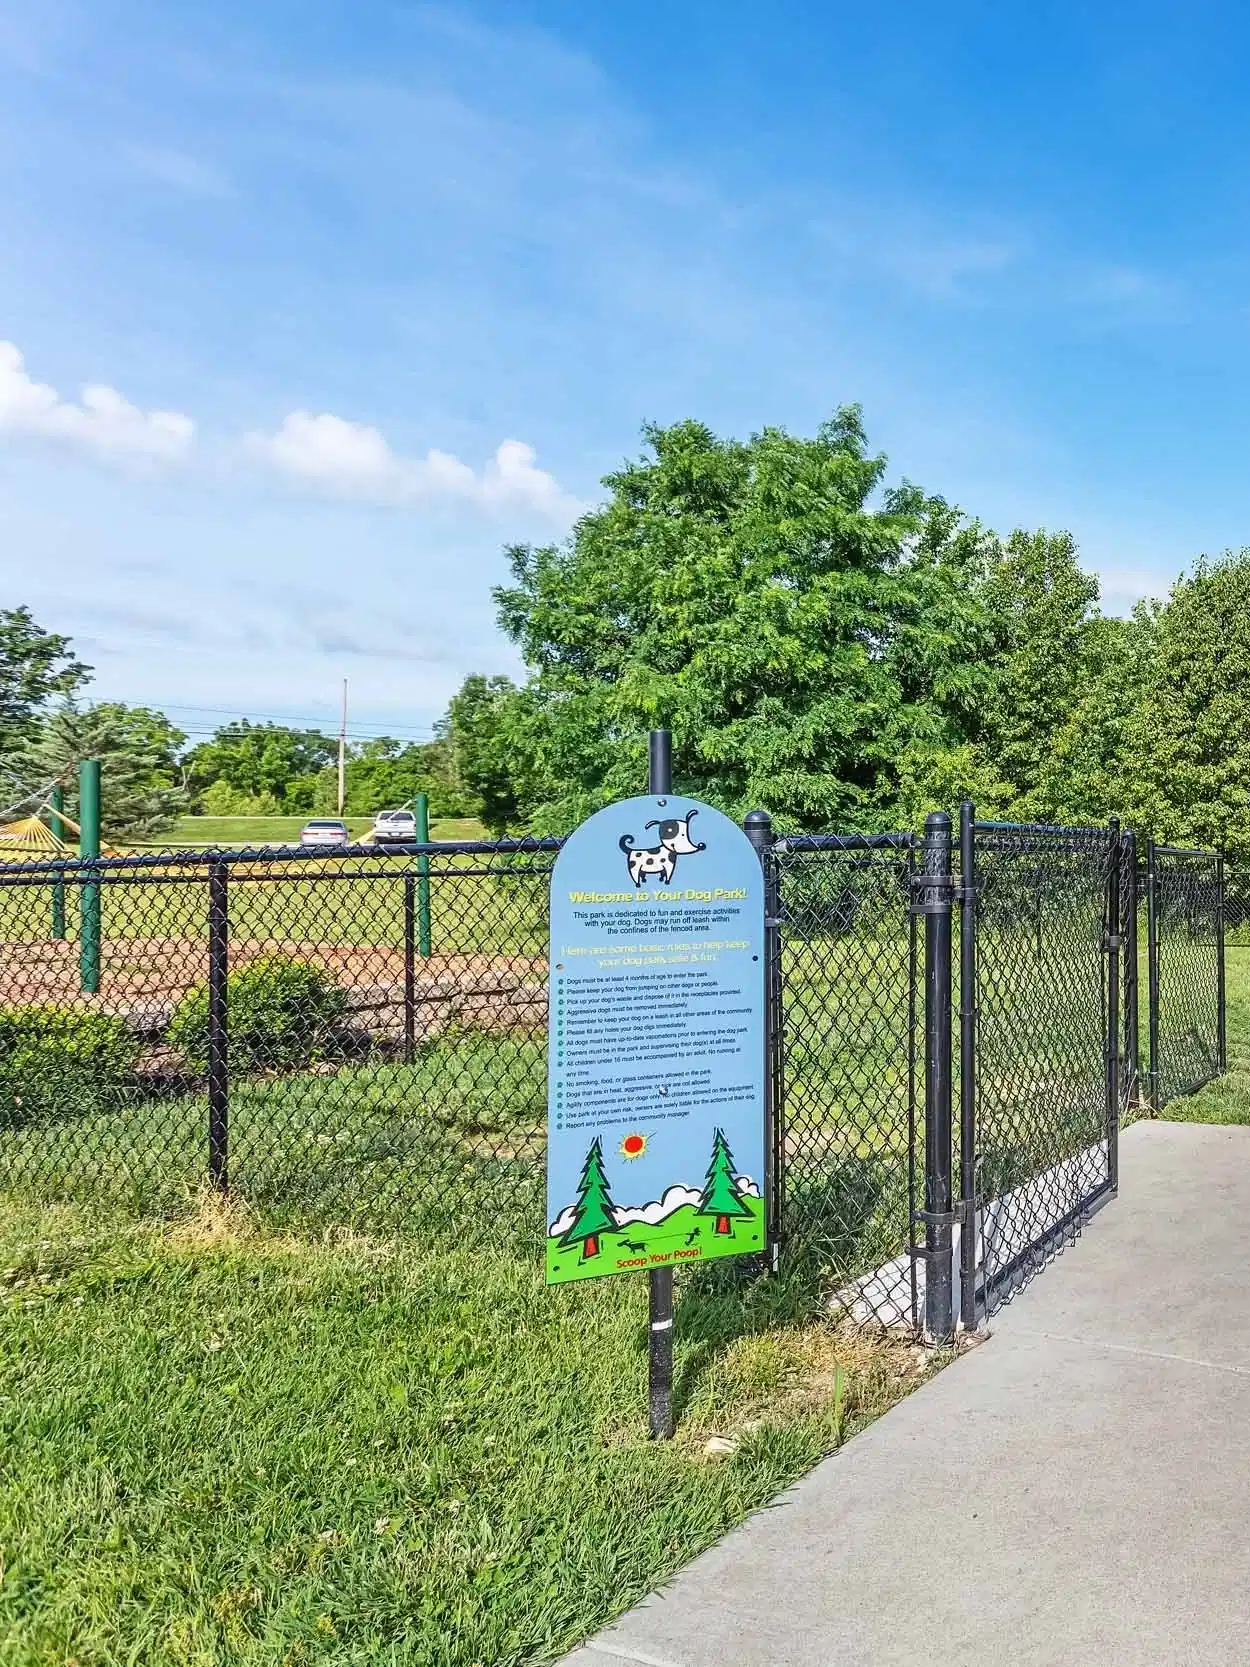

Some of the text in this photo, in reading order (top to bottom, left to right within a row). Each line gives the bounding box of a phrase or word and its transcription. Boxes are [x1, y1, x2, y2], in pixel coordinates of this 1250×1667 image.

[569, 888, 748, 904] Welcome to Your Dog Park!
[590, 912, 605, 920] park
[614, 910, 648, 918] dedicated
[601, 920, 616, 928] your
[617, 919, 632, 927] dog.
[634, 918, 652, 926] Dogs
[620, 926, 648, 934] confines
[616, 1246, 702, 1269] Scoop Your Poop!
